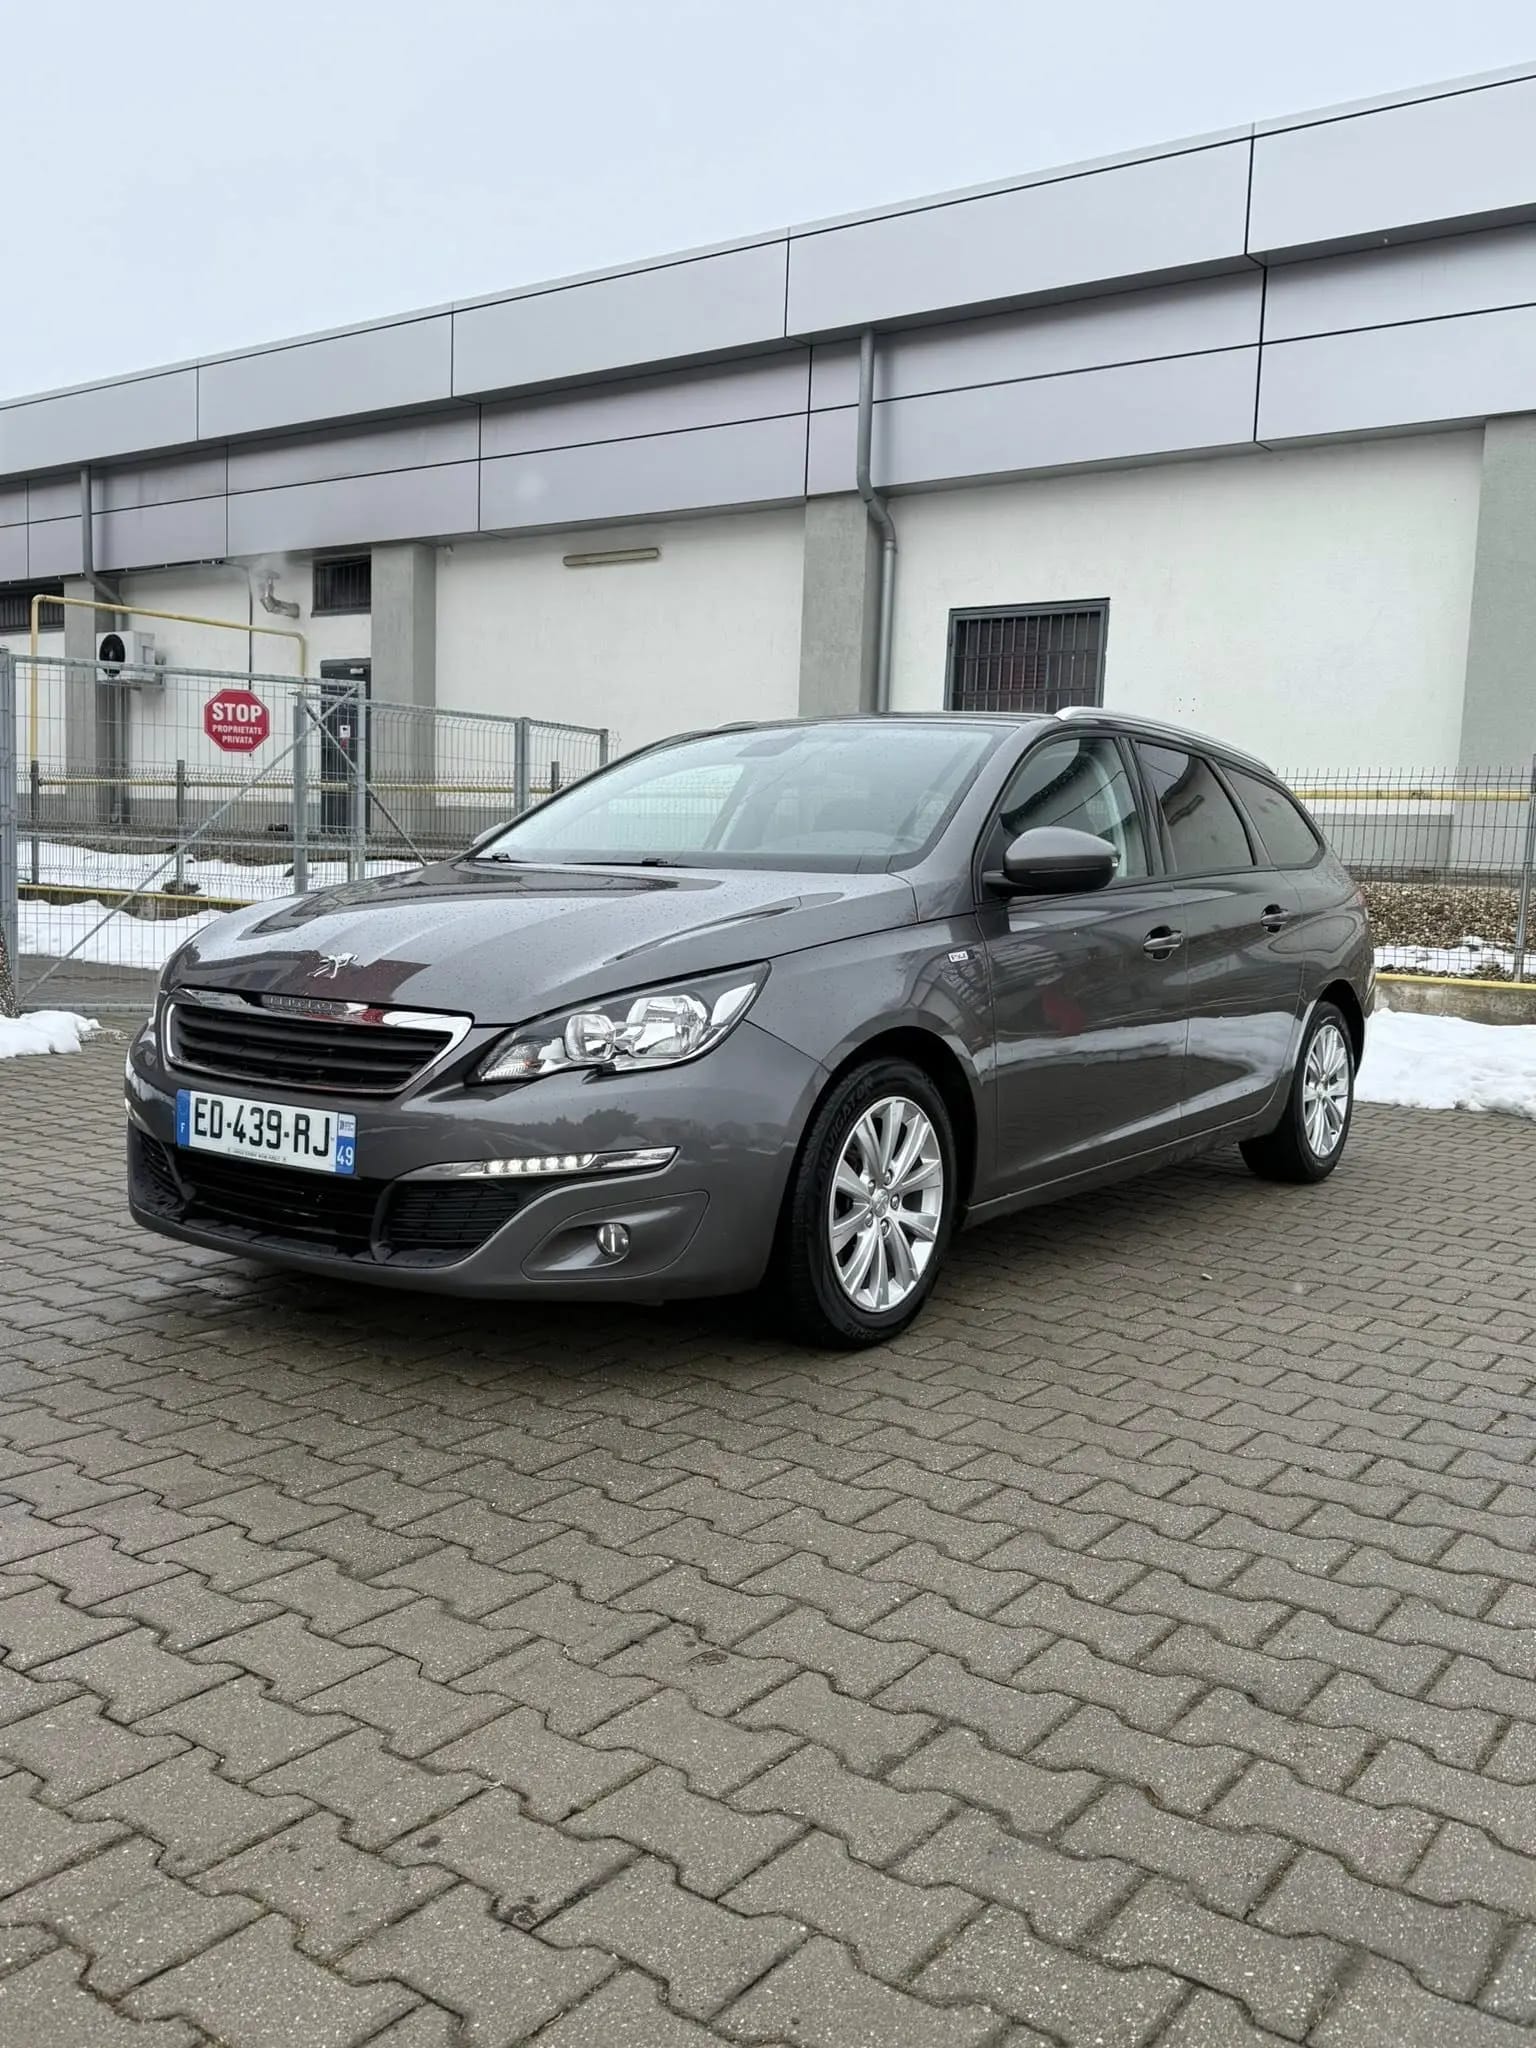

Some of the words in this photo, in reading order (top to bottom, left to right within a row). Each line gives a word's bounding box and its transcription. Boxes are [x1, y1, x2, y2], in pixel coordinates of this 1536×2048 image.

[212, 702, 262, 722] STOP
[212, 724, 262, 735] PROPRIETATE
[222, 735, 253, 744] PRIVATA
[180, 1122, 186, 1133] F
[194, 1097, 331, 1157] ED-439-RJ
[336, 1145, 353, 1167] 49
